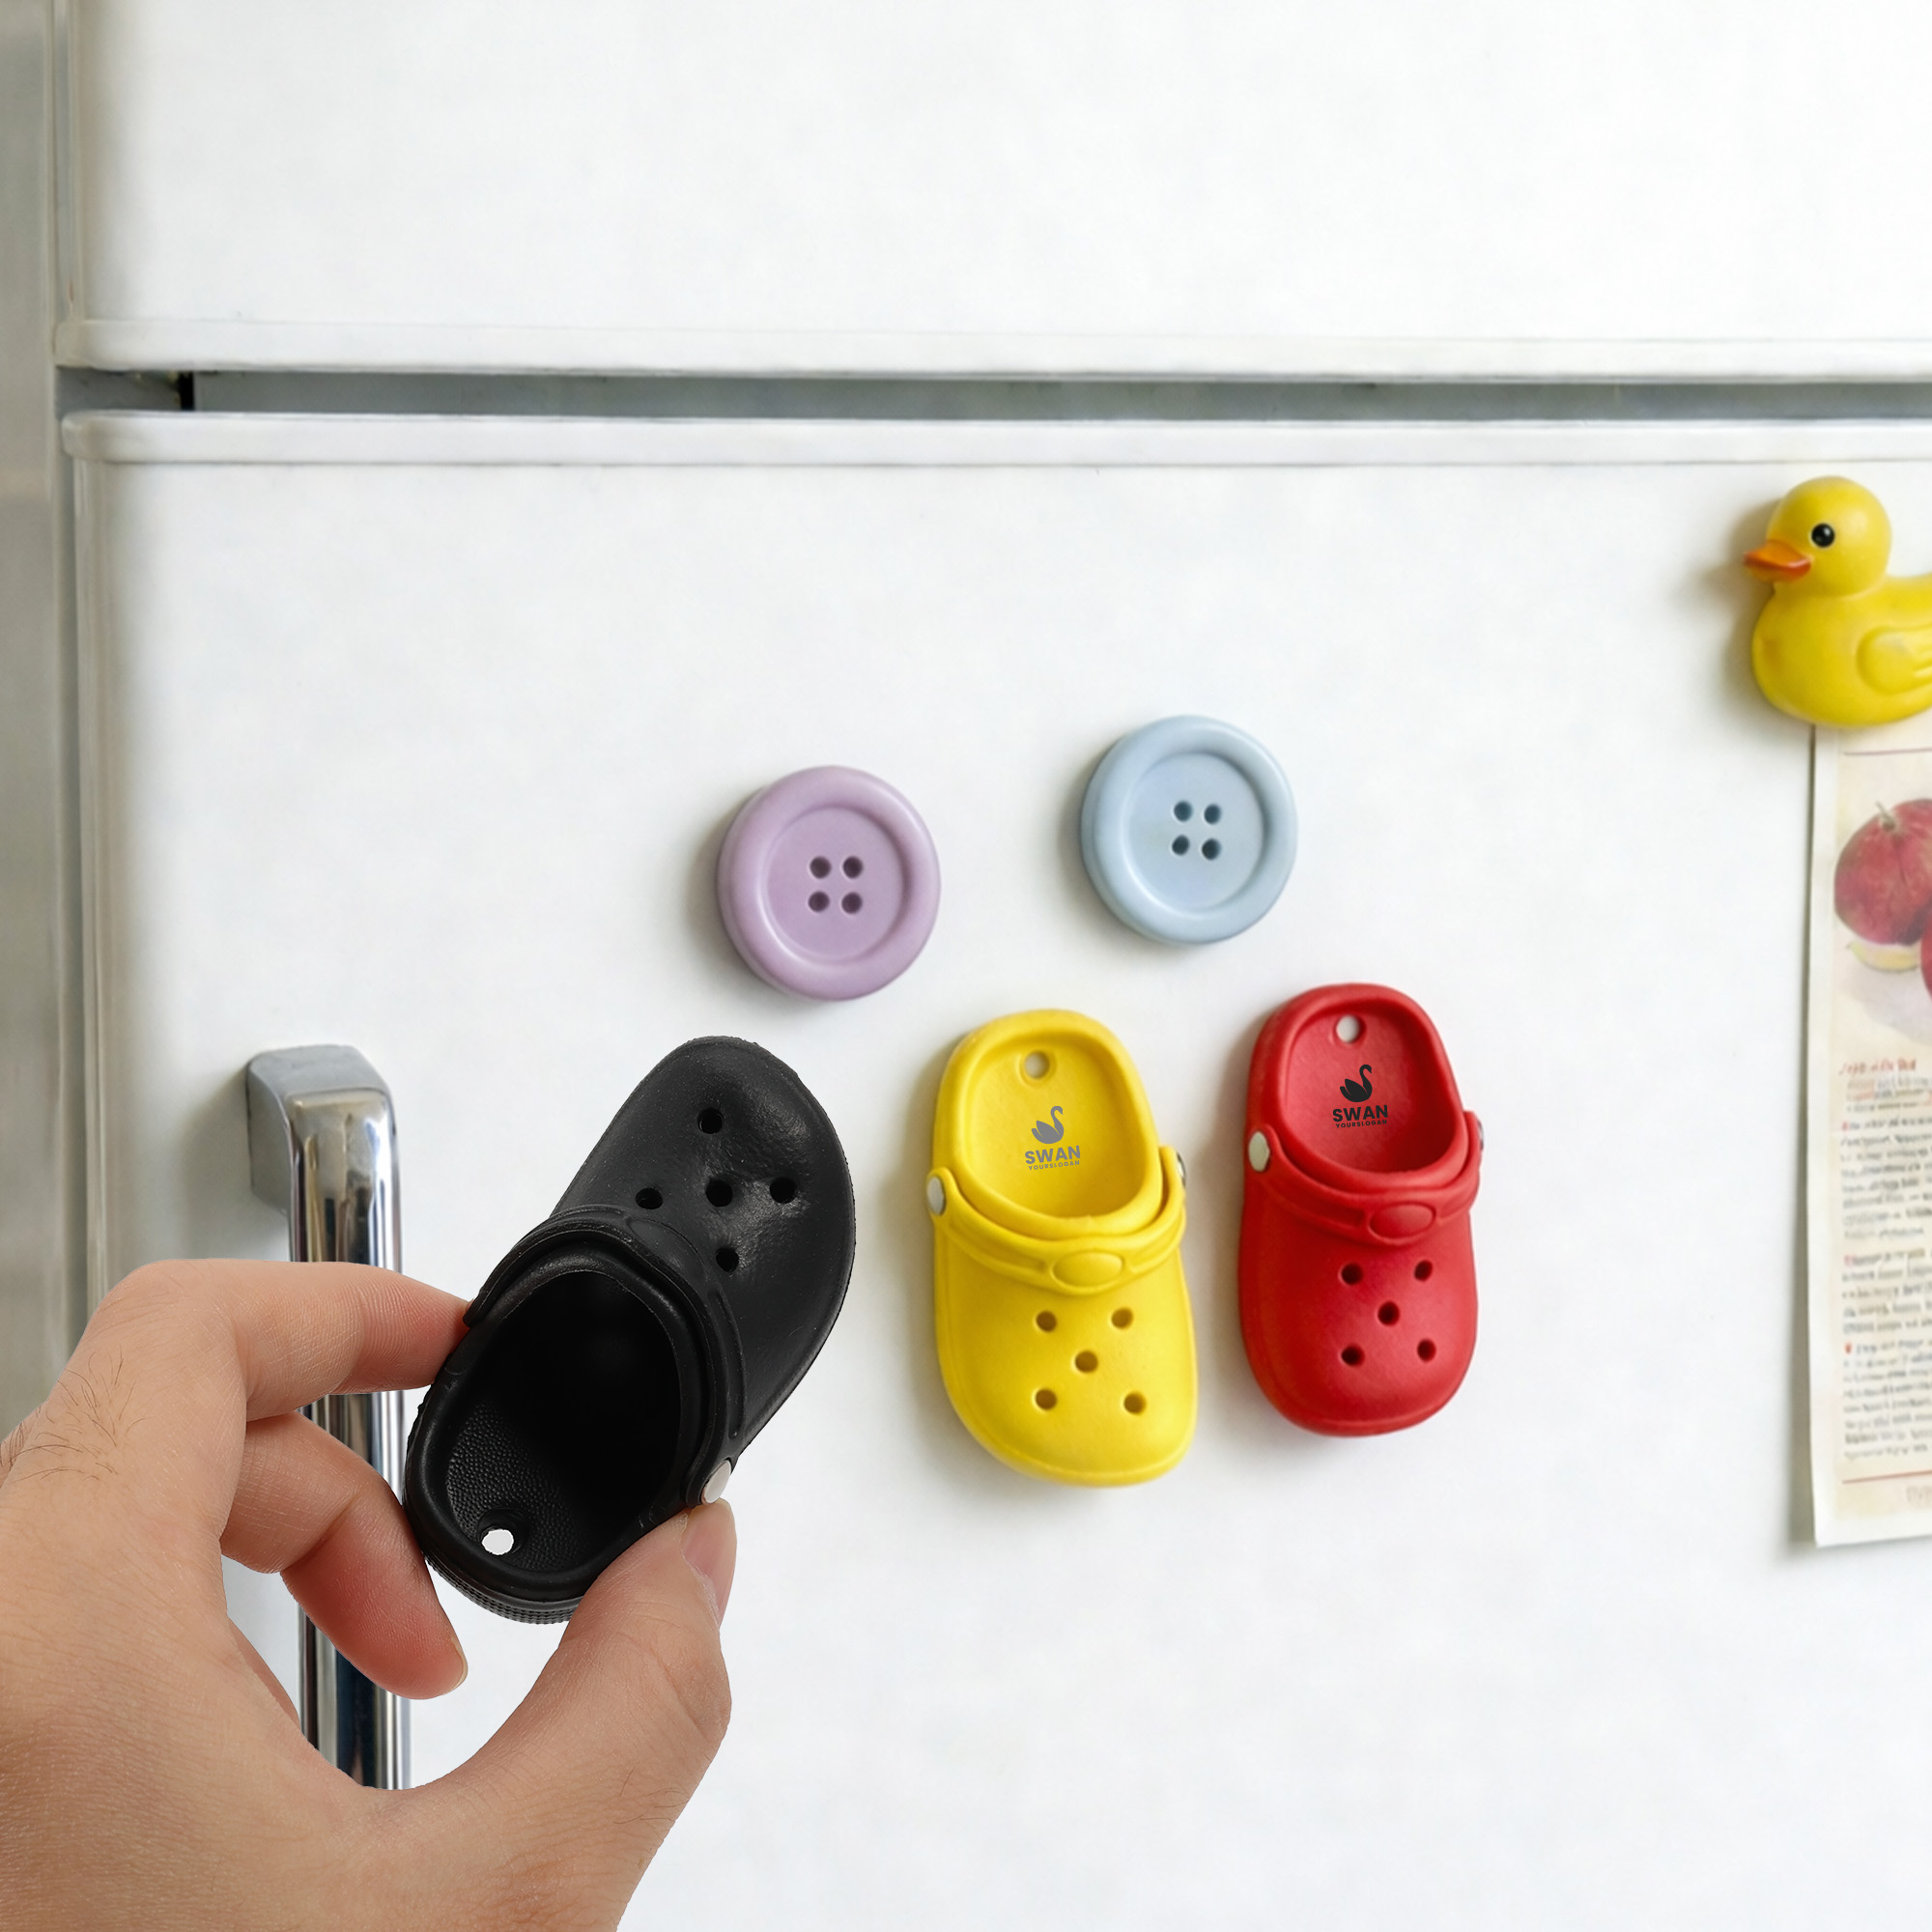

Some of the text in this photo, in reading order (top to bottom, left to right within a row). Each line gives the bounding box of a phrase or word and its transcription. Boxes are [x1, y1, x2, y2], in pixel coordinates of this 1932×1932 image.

[1333, 1105, 1388, 1122] SWAN
[1335, 1120, 1387, 1128] YOURSLOGAN
[1025, 1146, 1080, 1164] SWAN
[1028, 1160, 1080, 1170] YOURSLOGAN
